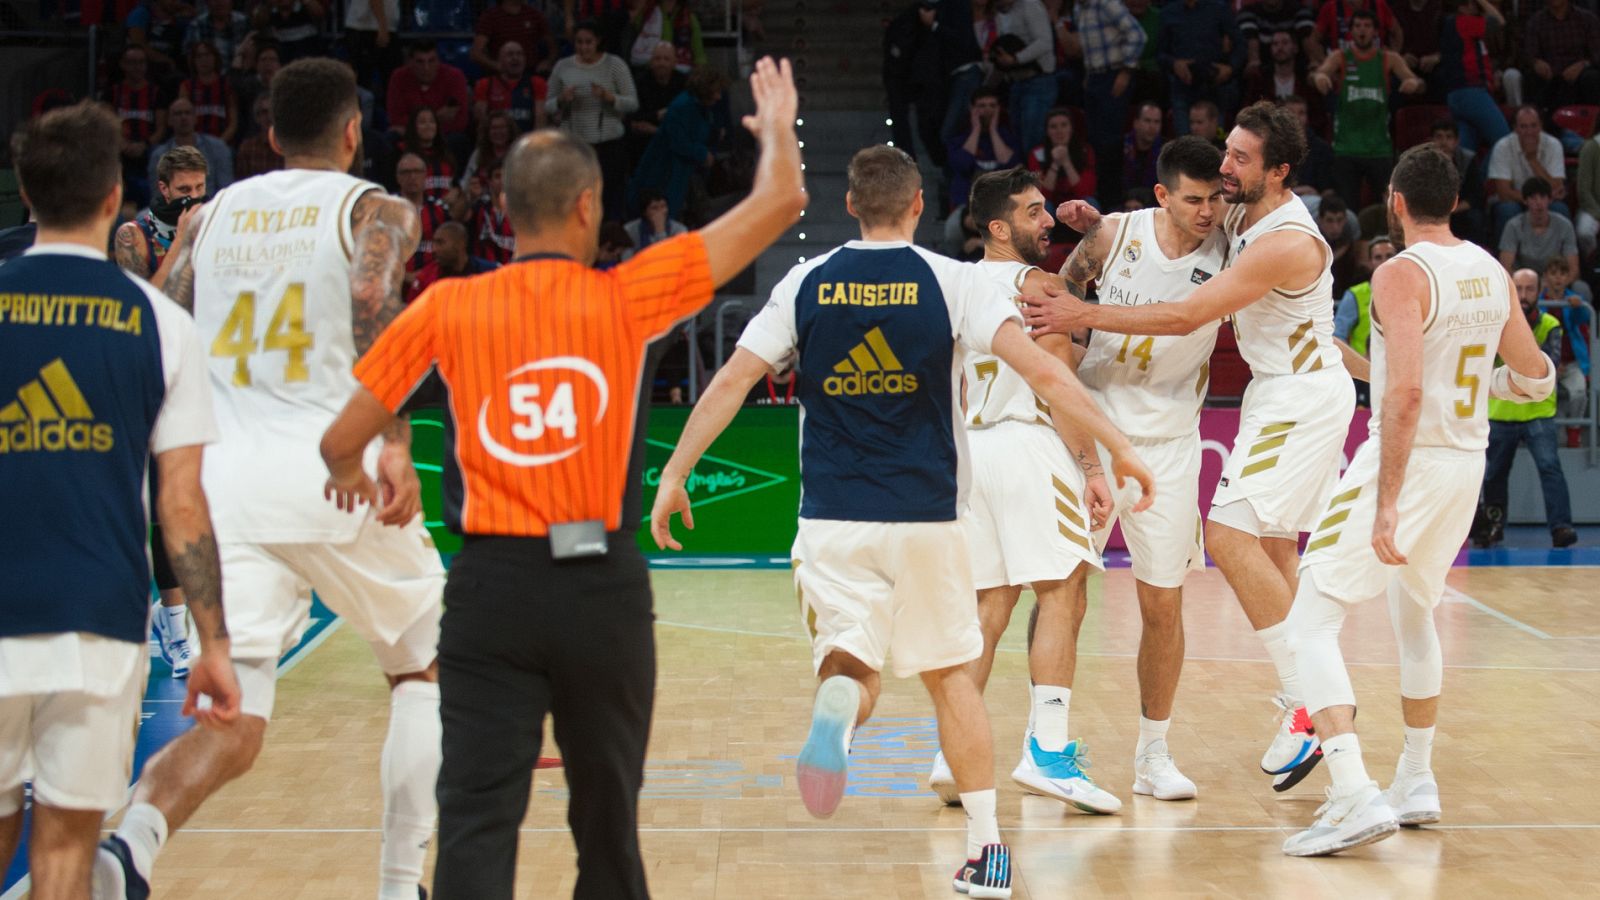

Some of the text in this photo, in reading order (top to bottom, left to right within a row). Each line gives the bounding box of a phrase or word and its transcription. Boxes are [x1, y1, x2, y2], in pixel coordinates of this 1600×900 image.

[232, 206, 320, 234] TAYLOR
[818, 282, 919, 307] CAUSEUR
[1456, 277, 1492, 301] RUDY
[209, 282, 316, 389] 44
[1115, 334, 1155, 372] 14
[823, 370, 919, 396] adidas
[974, 359, 999, 425] 7
[1454, 344, 1487, 420] 5
[509, 382, 577, 441] 54
